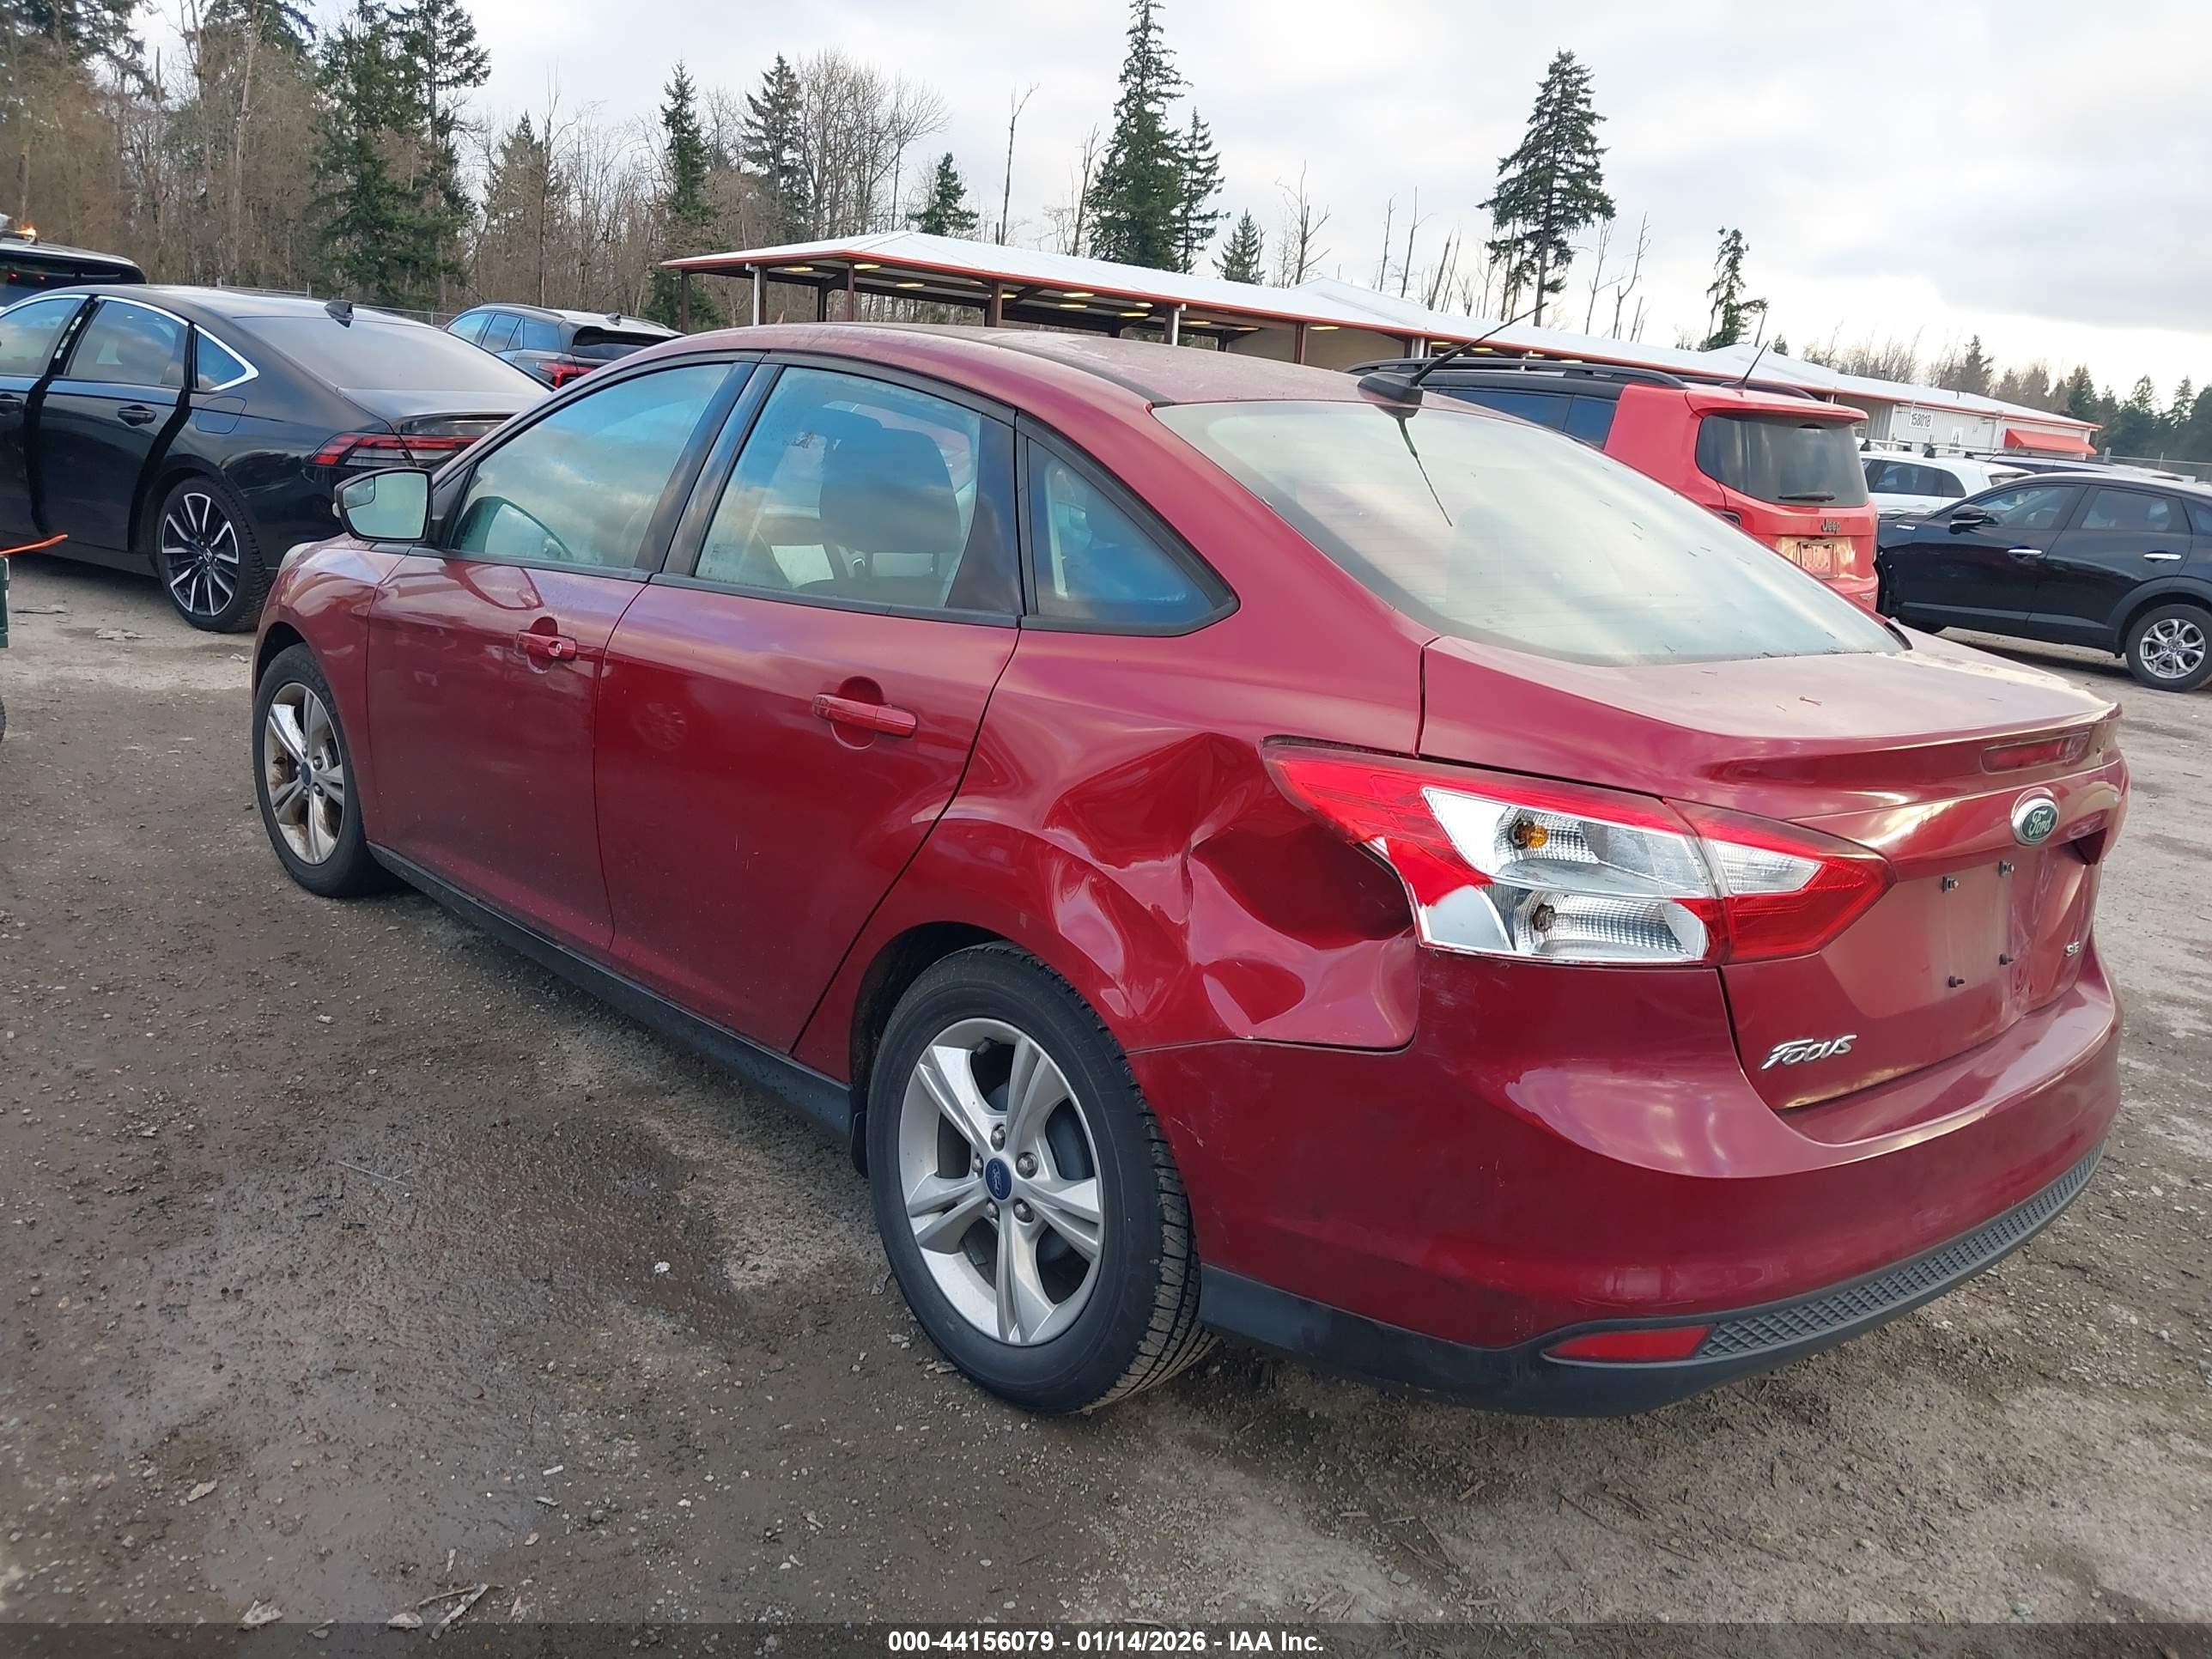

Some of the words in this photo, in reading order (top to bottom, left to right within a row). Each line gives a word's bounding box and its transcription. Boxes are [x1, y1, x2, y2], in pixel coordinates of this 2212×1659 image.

[1821, 519, 1840, 534] Jeep
[2028, 809, 2053, 836] Ford
[2066, 940, 2080, 957] SE
